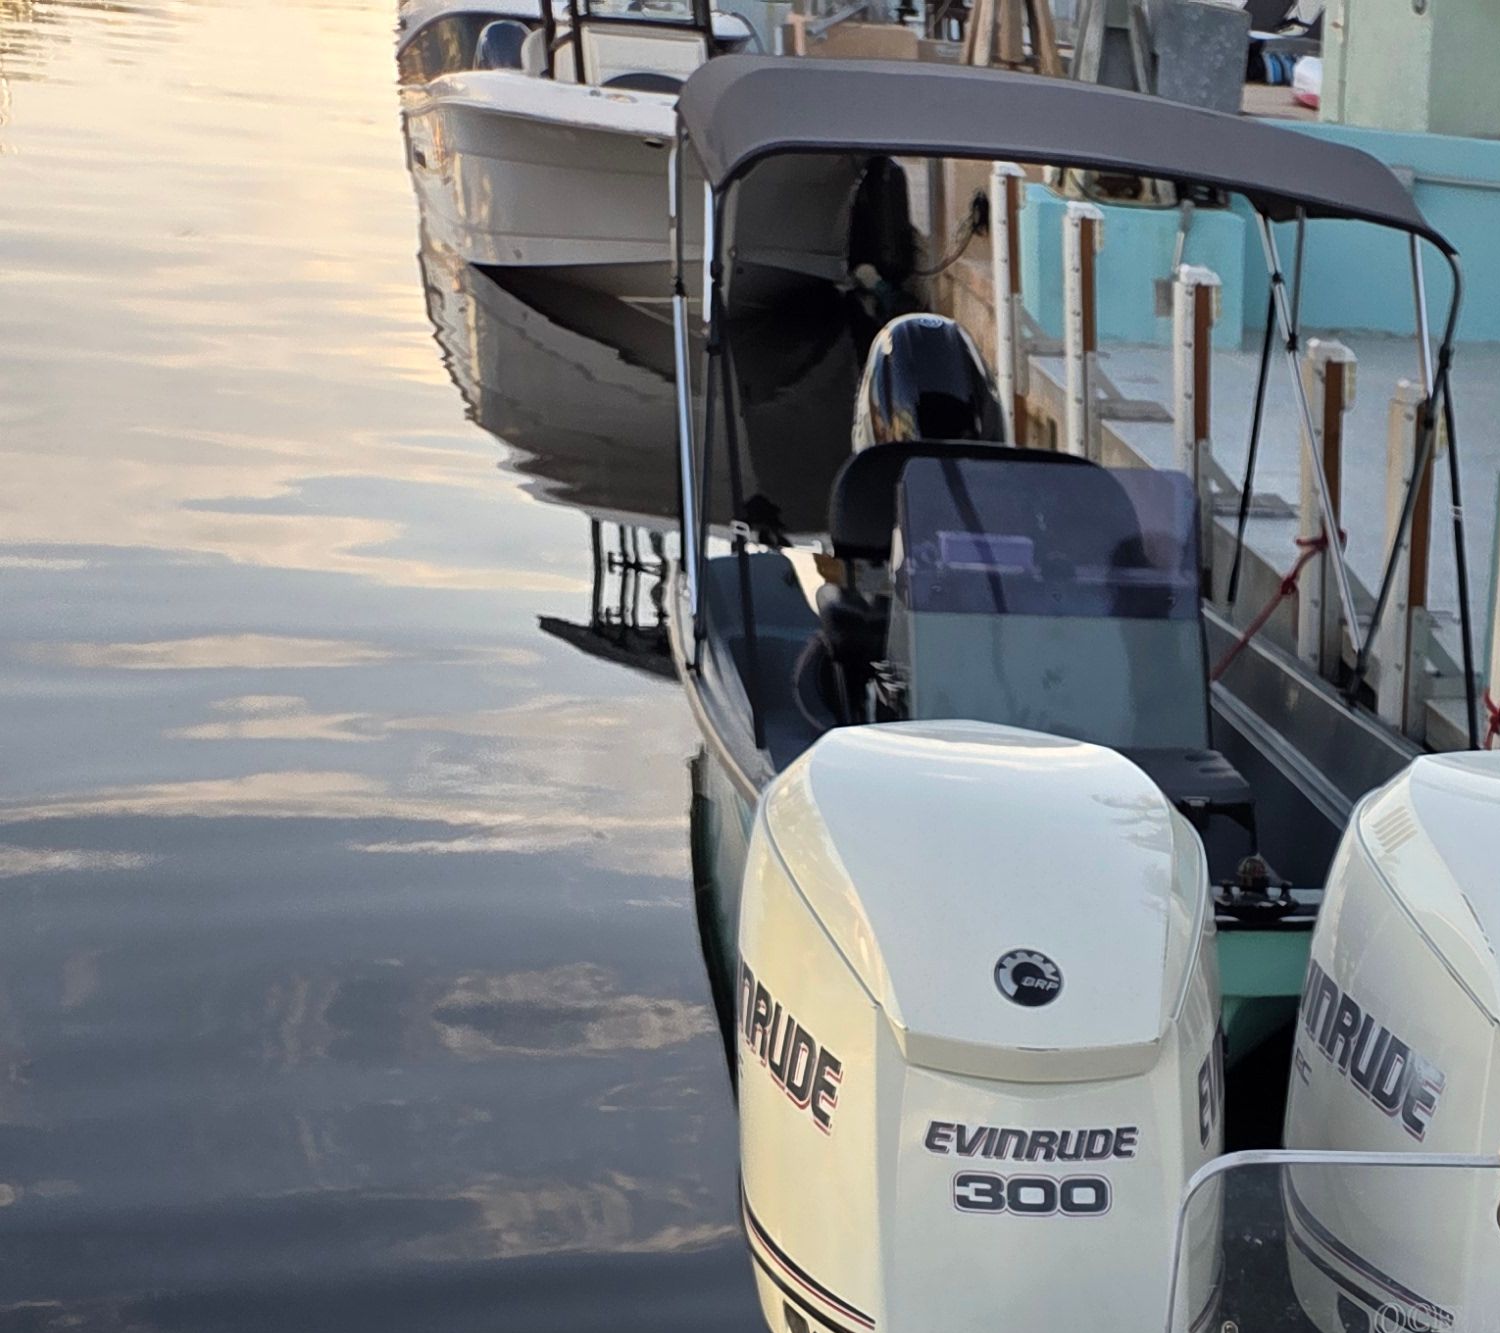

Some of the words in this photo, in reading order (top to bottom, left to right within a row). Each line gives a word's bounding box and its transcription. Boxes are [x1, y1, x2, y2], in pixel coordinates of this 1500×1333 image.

[740, 957, 844, 1136] NRUDE
[924, 1120, 1139, 1163] EVINRUDE
[955, 1173, 1110, 1214] 300
